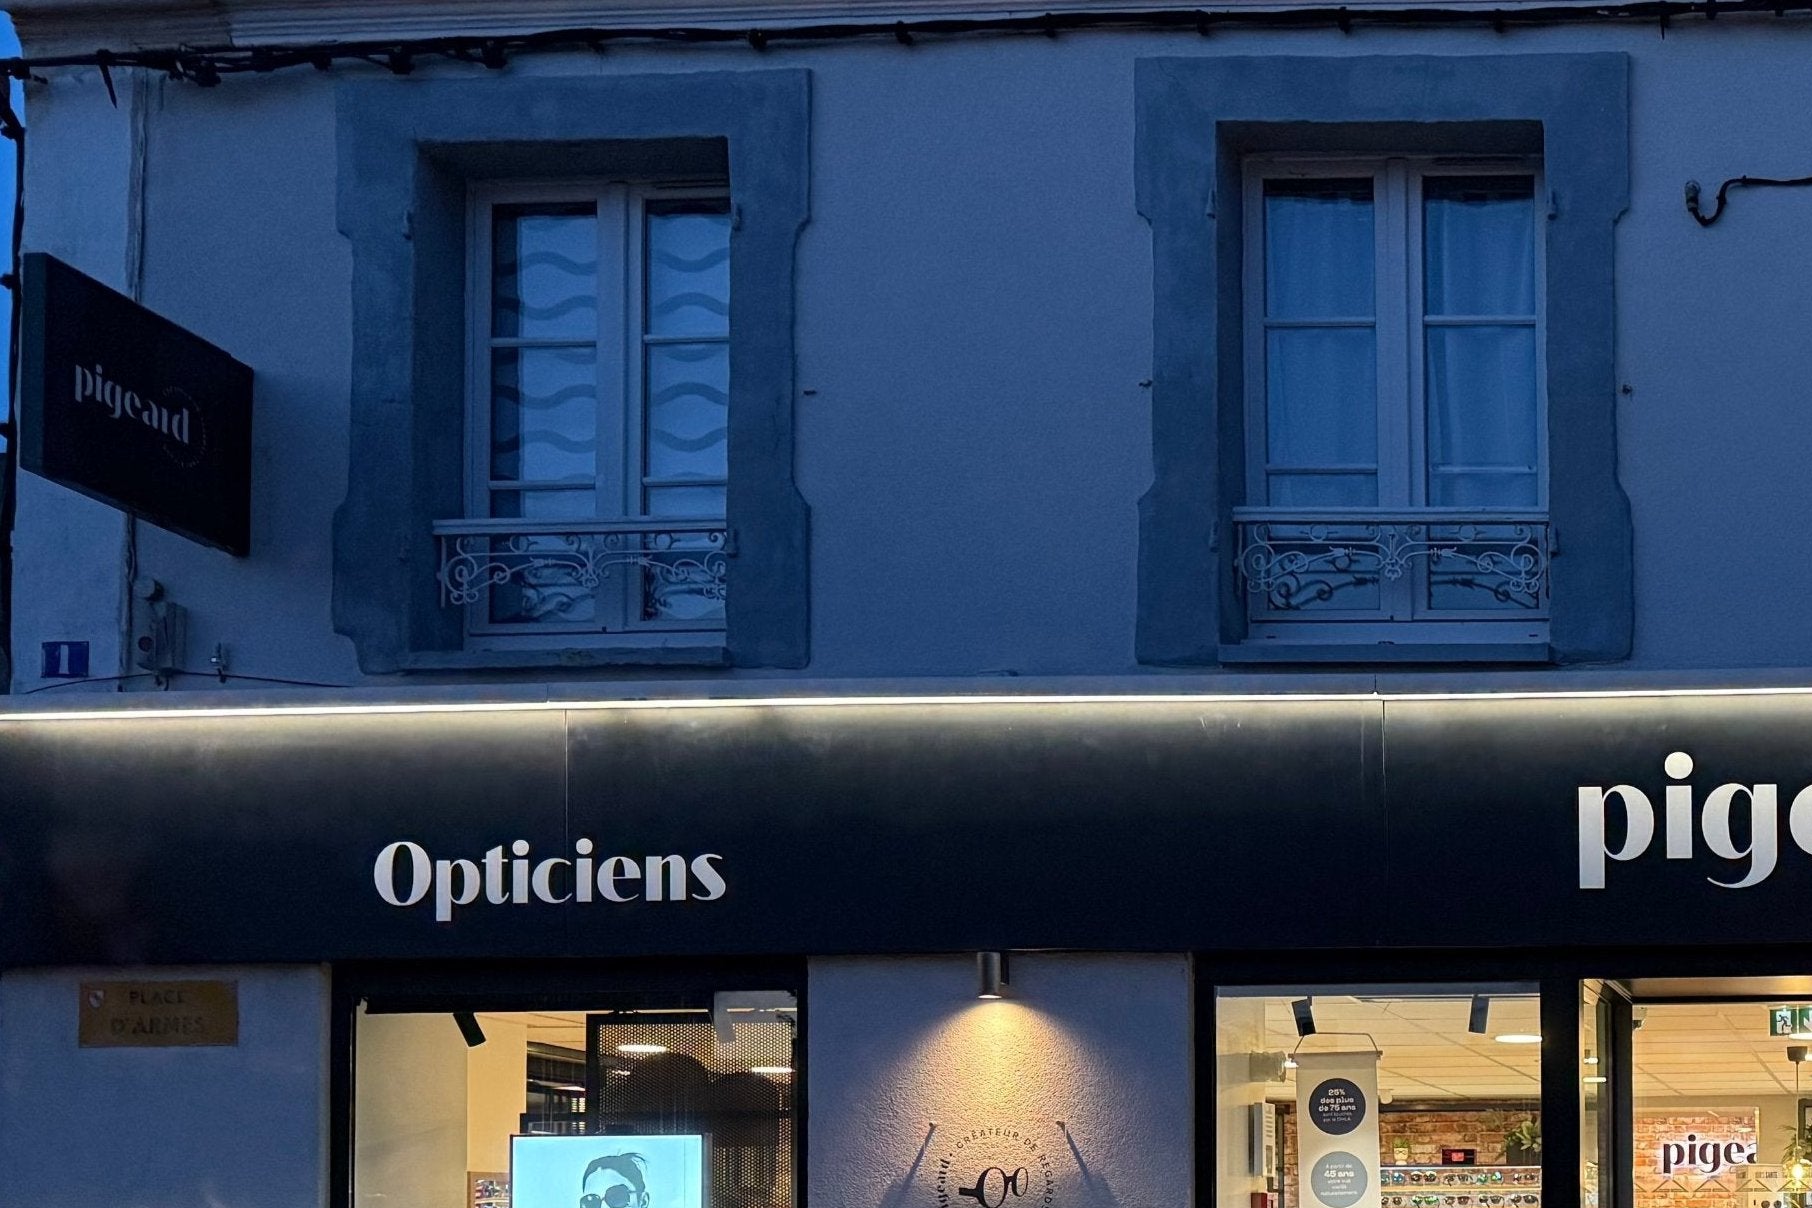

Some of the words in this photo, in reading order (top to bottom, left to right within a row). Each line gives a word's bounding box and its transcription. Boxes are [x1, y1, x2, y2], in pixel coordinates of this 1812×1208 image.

[75, 364, 189, 445] pigeard
[373, 838, 727, 922] Opticiens
[956, 1128, 1020, 1149] CRÉATEUR
[1023, 1137, 1039, 1152] DE
